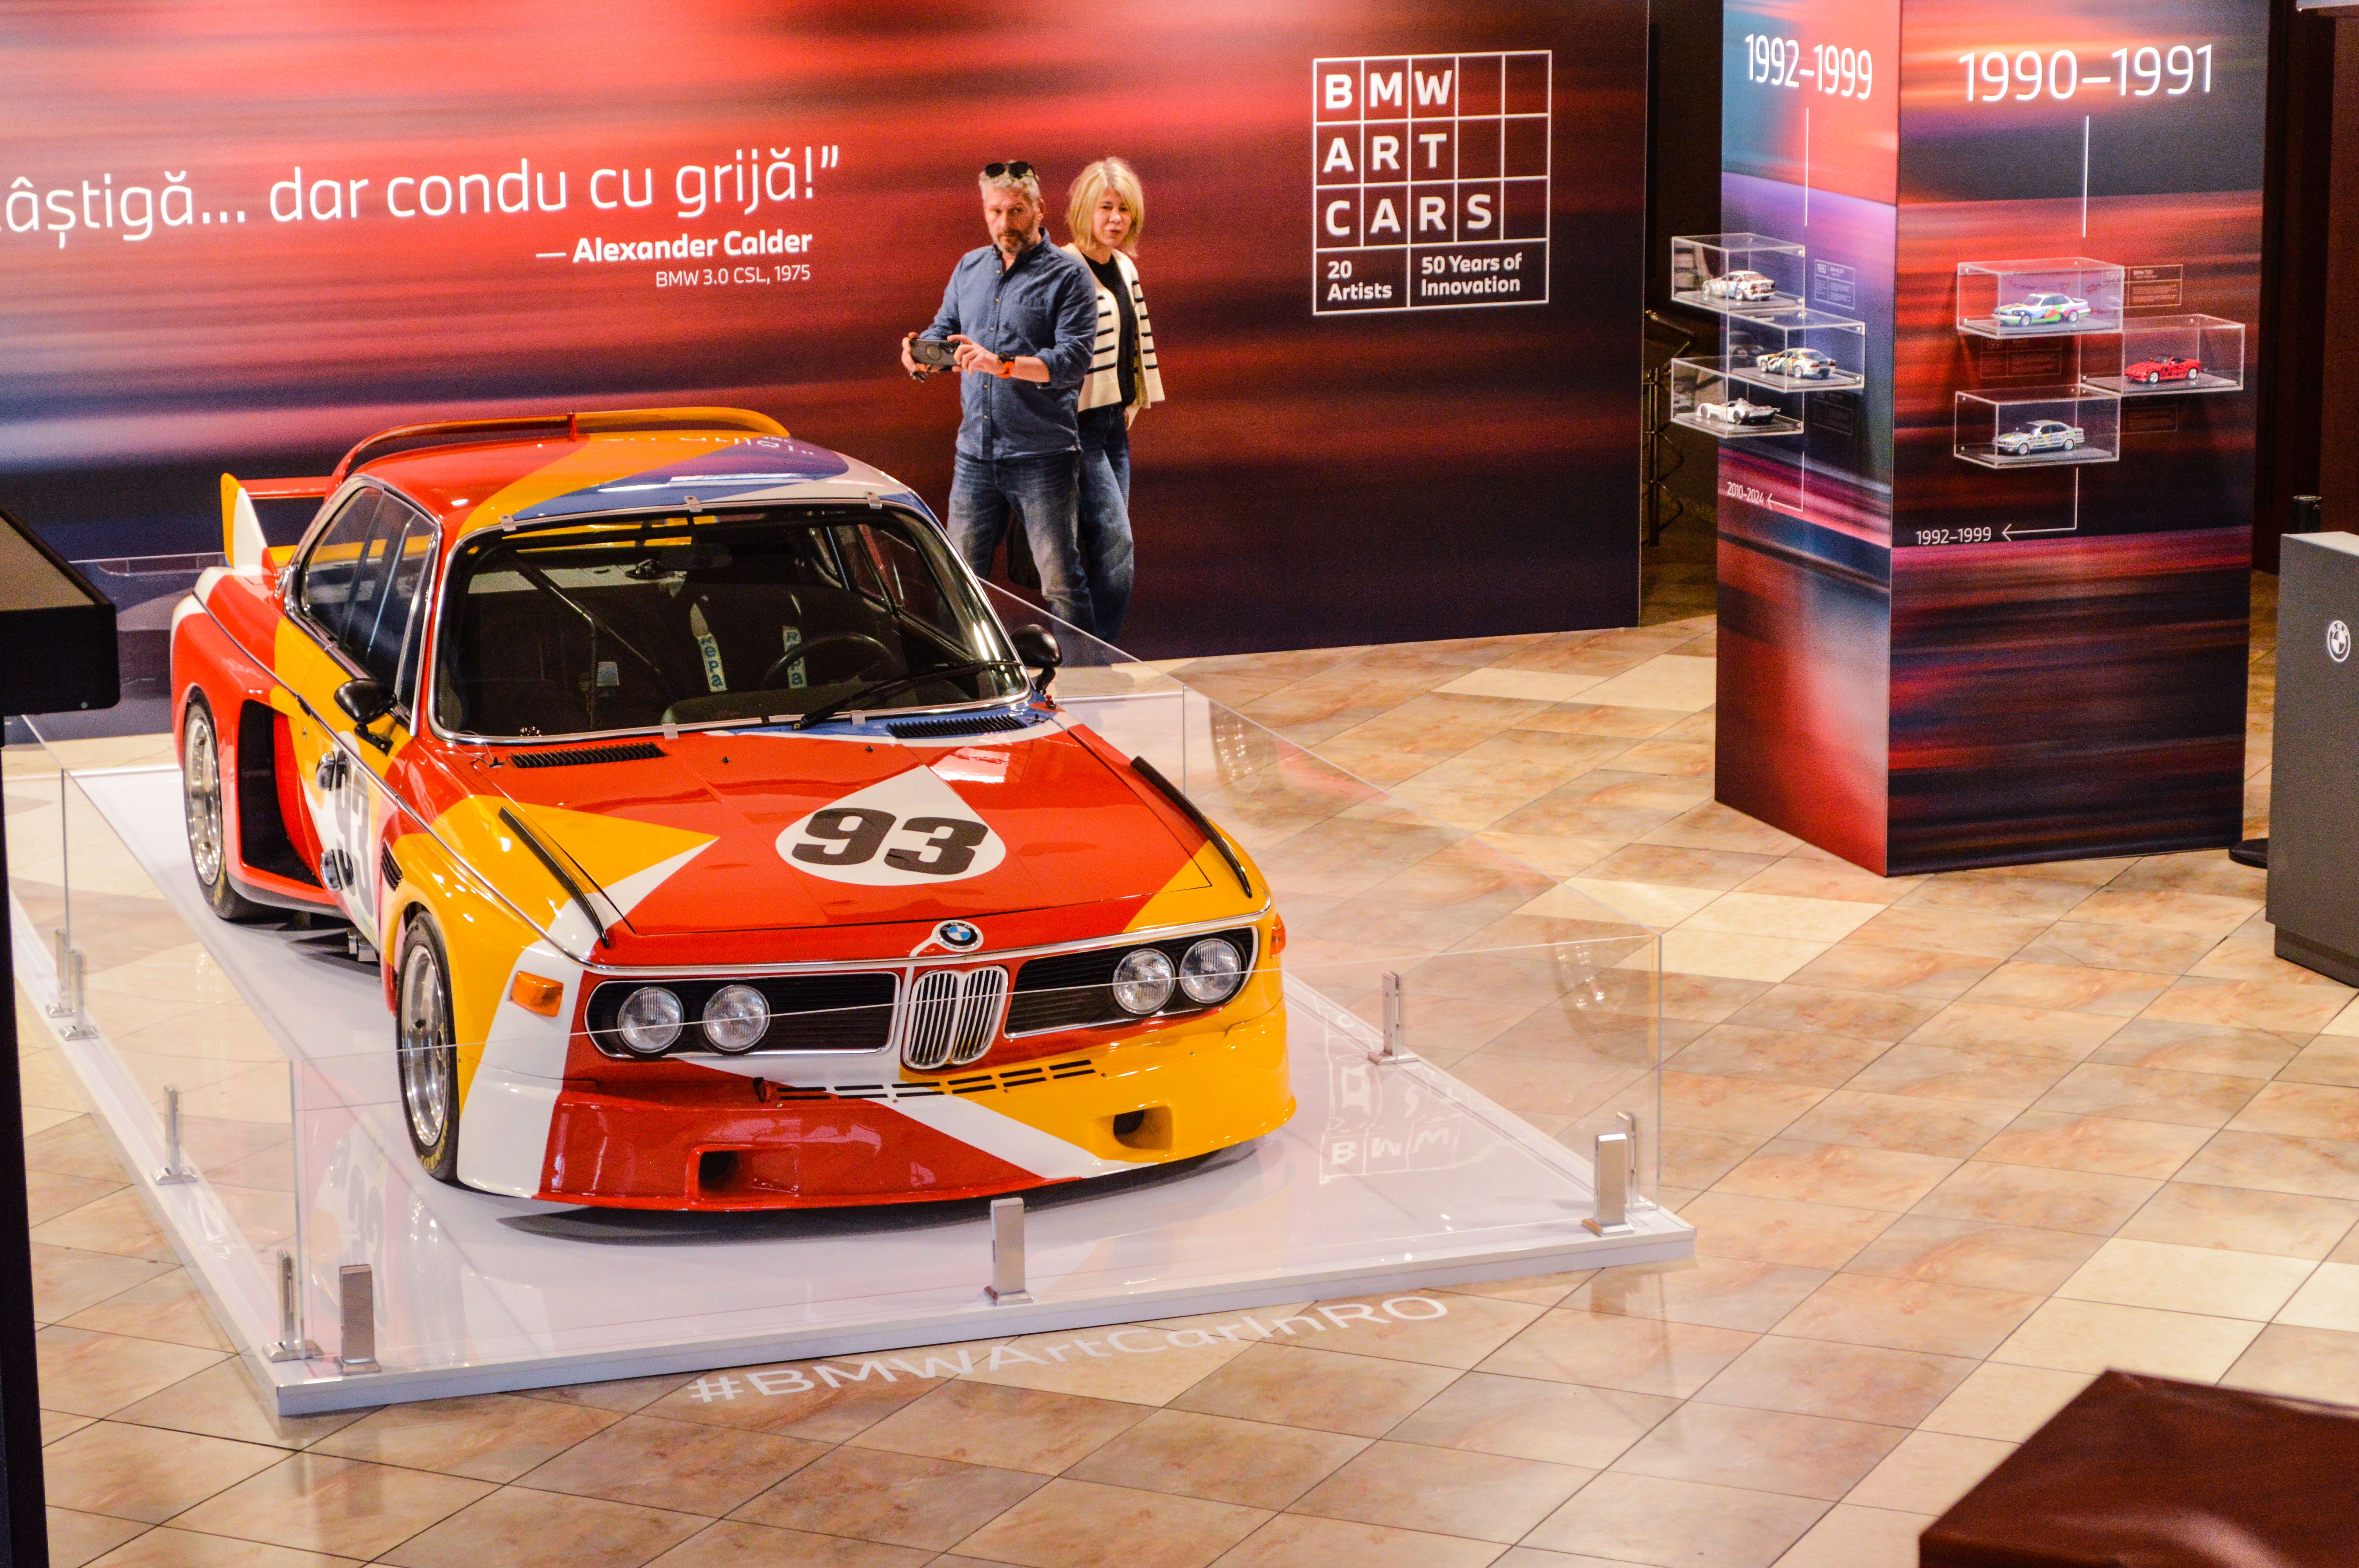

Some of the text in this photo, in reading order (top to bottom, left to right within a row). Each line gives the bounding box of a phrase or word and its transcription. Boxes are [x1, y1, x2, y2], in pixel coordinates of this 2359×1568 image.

[1326, 70, 1452, 109] BMW
[1323, 133, 1447, 172] ART
[0, 170, 245, 249] âștigă...
[270, 167, 369, 222] dar
[387, 158, 567, 217] condu
[590, 168, 652, 209] cu
[1326, 194, 1492, 236] CARS
[572, 233, 718, 263] Alexander
[724, 229, 813, 256] Calder
[1422, 252, 1523, 274] 50 Years of
[656, 264, 811, 287] BMW 3.0 CSL, 1975
[1328, 260, 1352, 279] 20
[1421, 276, 1520, 296] Innovation
[2106, 270, 2123, 280] 199
[1327, 282, 1392, 301] Artists
[791, 808, 989, 875] 93
[687, 1296, 1448, 1403] #BMWArtCarInRO
